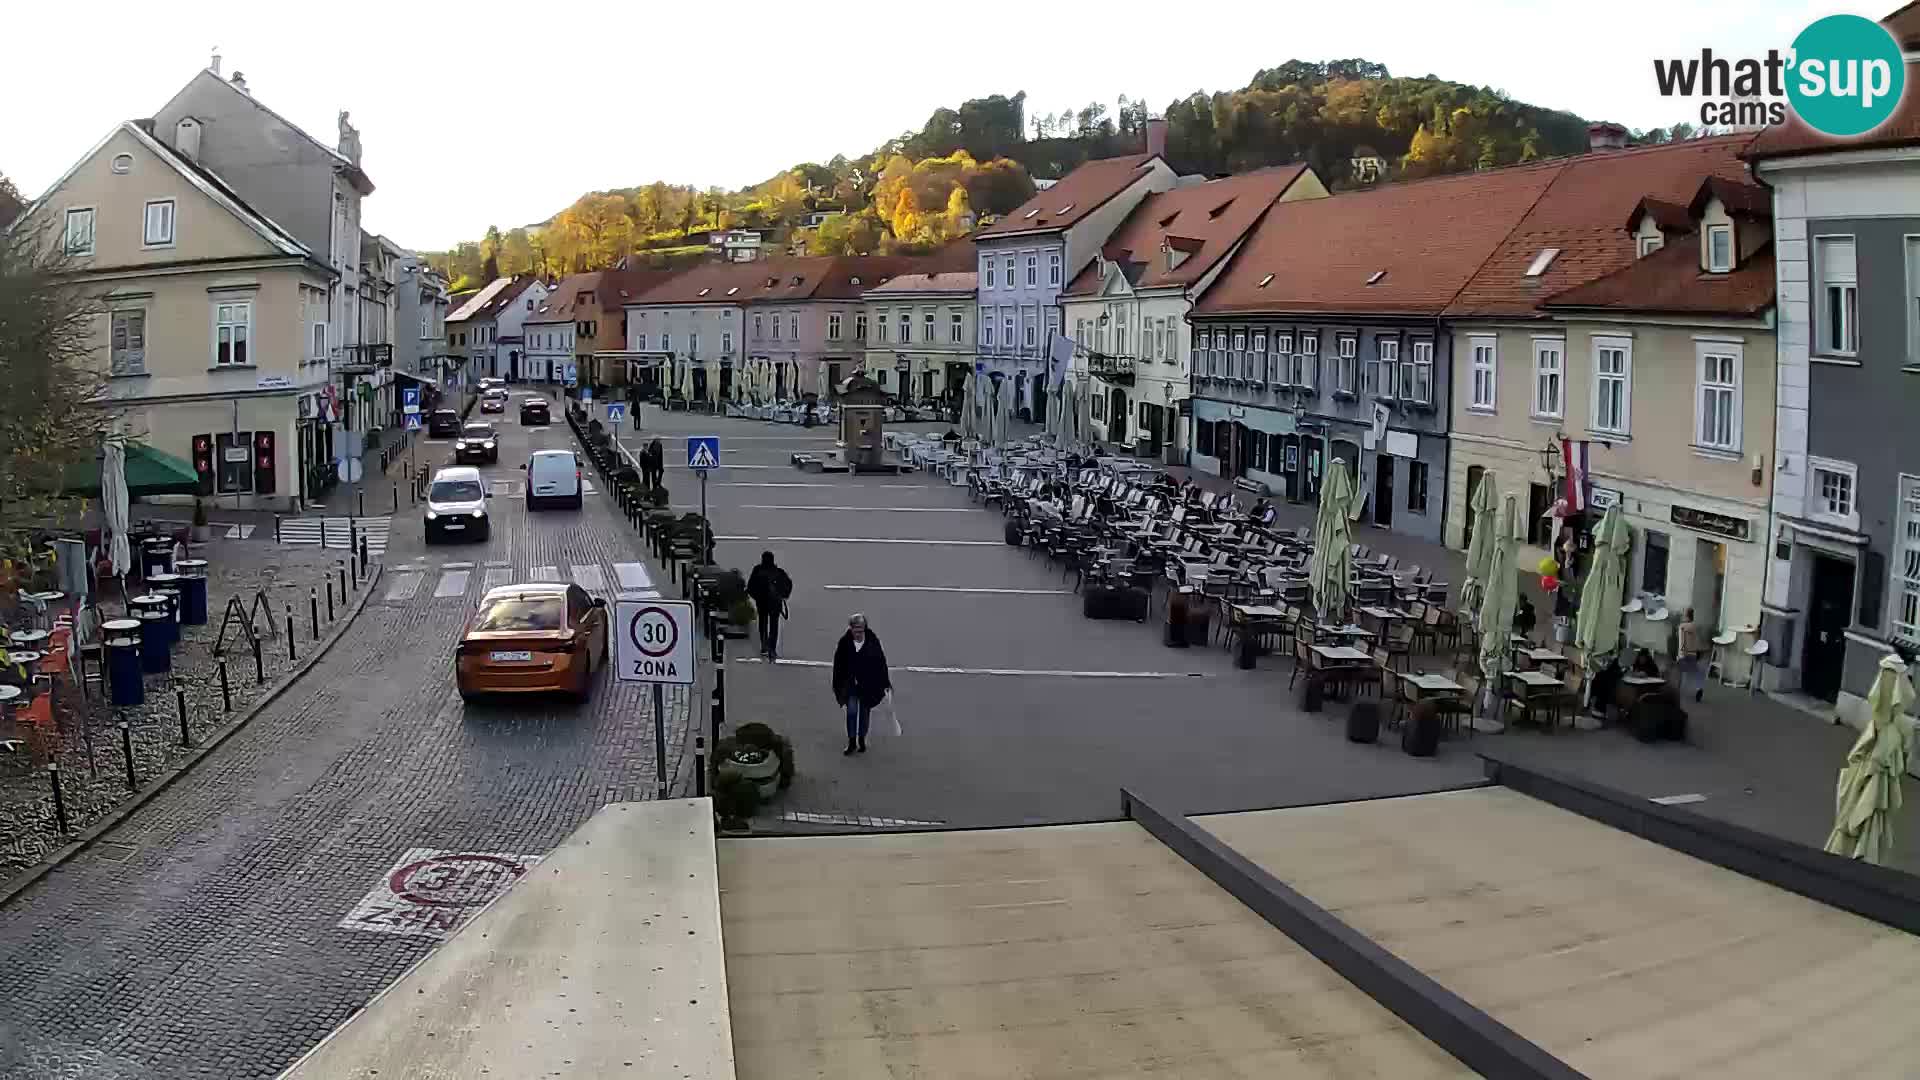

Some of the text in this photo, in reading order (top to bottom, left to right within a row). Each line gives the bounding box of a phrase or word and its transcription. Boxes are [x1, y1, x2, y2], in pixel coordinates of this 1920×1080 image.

[407, 392, 415, 402] P
[643, 623, 666, 643] 30
[633, 660, 677, 676] ZONA
